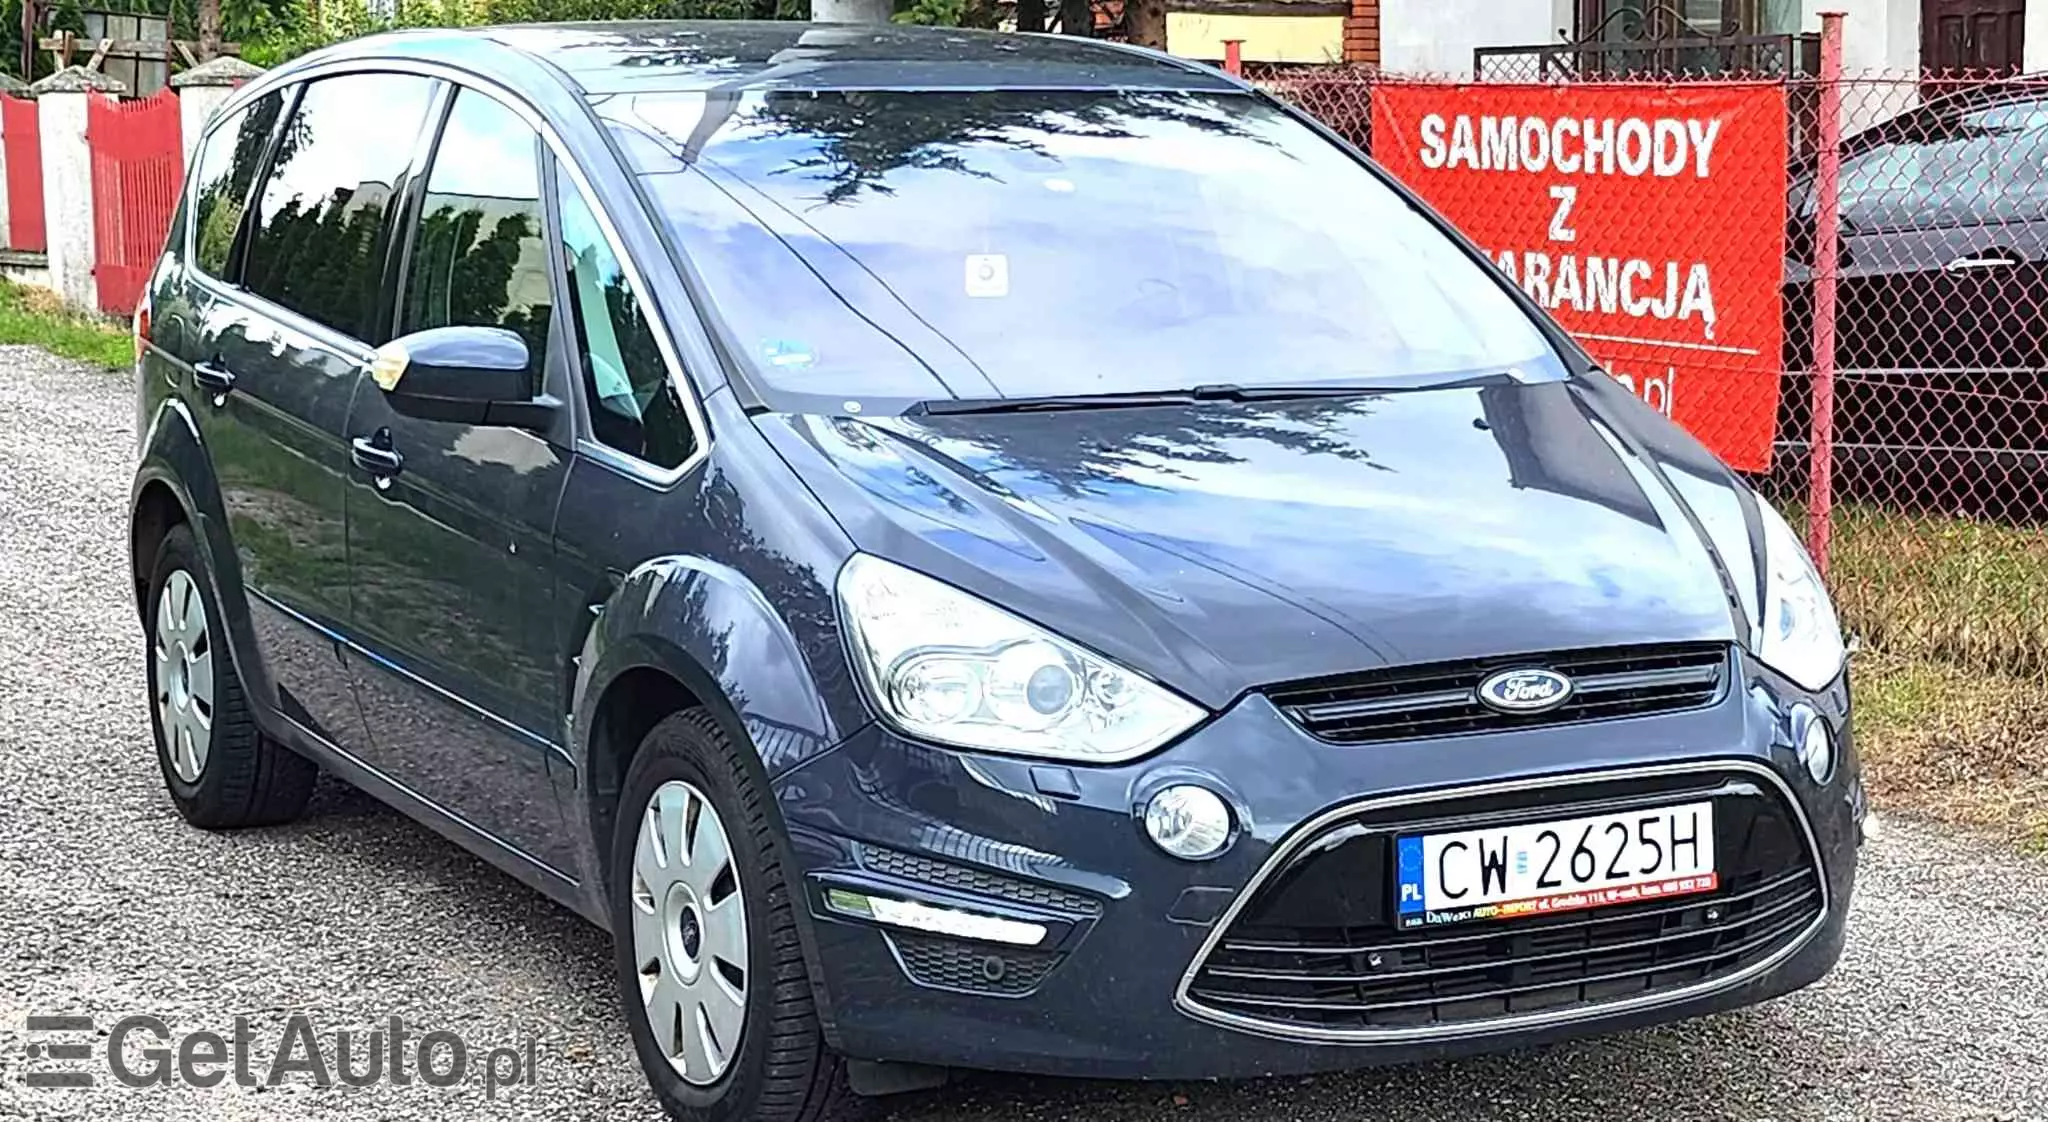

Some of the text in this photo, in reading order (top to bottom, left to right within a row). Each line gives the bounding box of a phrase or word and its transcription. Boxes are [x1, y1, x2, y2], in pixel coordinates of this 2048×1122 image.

[1419, 113, 1721, 178] SAMOCHODY
[1548, 185, 1578, 242] Z
[1482, 249, 1716, 340] ARANCJĄ
[1503, 675, 1554, 701] Ford
[1438, 835, 1508, 899] CW
[1535, 811, 1699, 889] 2625H
[1401, 883, 1423, 901] PL
